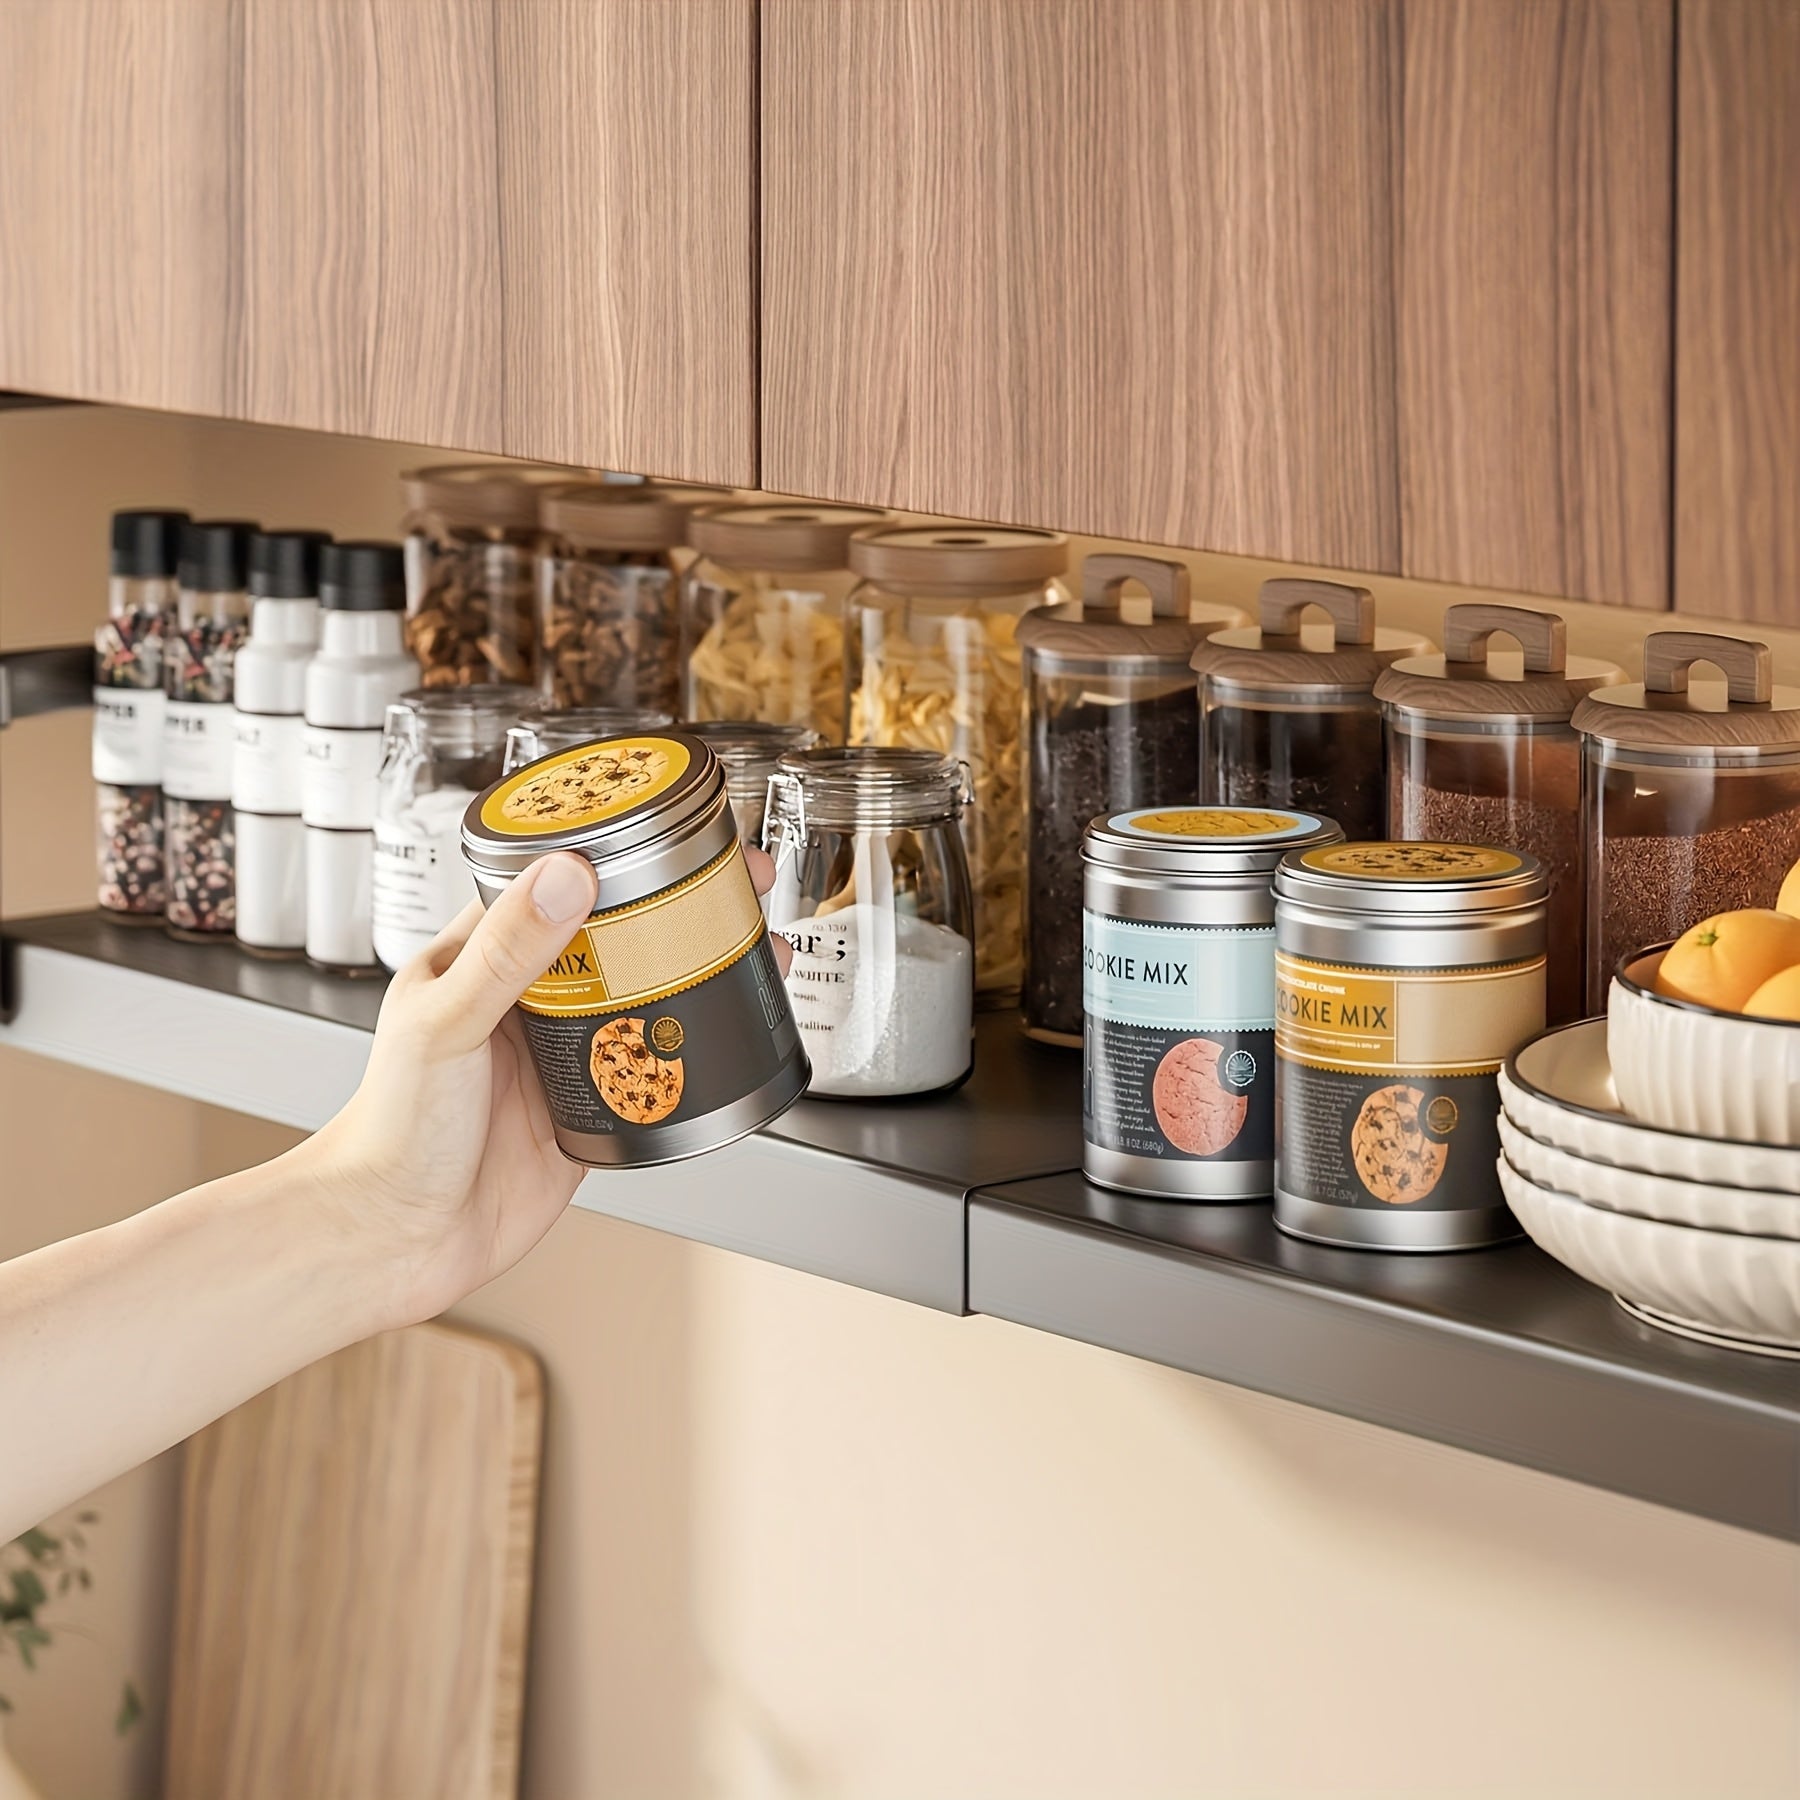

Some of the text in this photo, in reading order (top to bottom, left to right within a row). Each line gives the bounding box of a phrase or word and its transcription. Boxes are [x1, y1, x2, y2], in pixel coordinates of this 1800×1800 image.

[548, 952, 592, 977] MIX
[794, 970, 845, 983] WHITE
[1143, 961, 1188, 986] MIX
[1277, 987, 1387, 1029] COOKIE MIX
